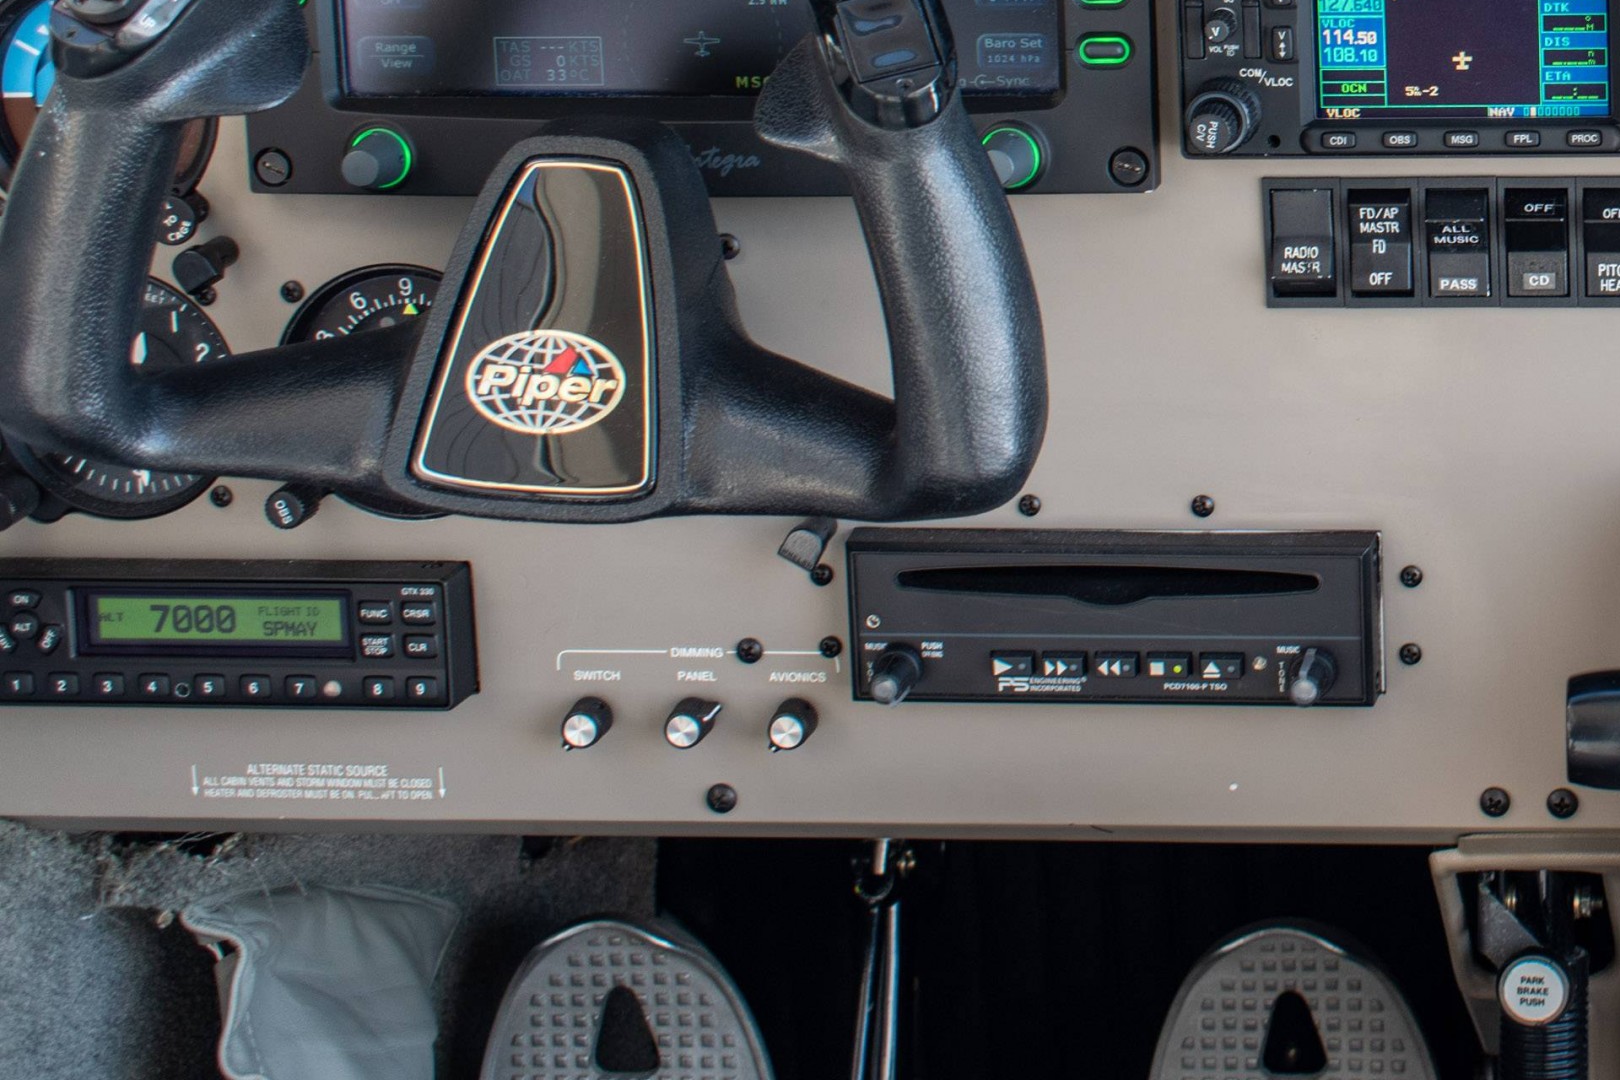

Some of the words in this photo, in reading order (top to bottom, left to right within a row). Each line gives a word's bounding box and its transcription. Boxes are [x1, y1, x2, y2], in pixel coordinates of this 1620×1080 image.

[1524, 203, 1552, 212] OFF
[1359, 208, 1398, 220] FD/AP
[1360, 222, 1399, 233] MASTR
[1373, 240, 1386, 254] FD
[1284, 247, 1318, 260] RADIO
[1369, 273, 1392, 286] OFF
[1440, 279, 1477, 290] PASS
[1529, 275, 1549, 286] CD
[477, 364, 617, 406] Piper
[150, 604, 237, 634] 7000
[361, 609, 388, 619] FUNC
[262, 622, 317, 637] SPMAY
[671, 648, 724, 658] DIMMING
[574, 670, 620, 681] SWITCH
[678, 671, 717, 682] PANEL
[769, 672, 826, 682] AVIONICS
[247, 764, 305, 775] ALTERNATE
[308, 765, 343, 776] STATIC
[346, 765, 388, 776] SOURCE
[1520, 976, 1544, 985] PARK
[1517, 987, 1549, 995] BRAKE
[1520, 998, 1545, 1006] PUSH
